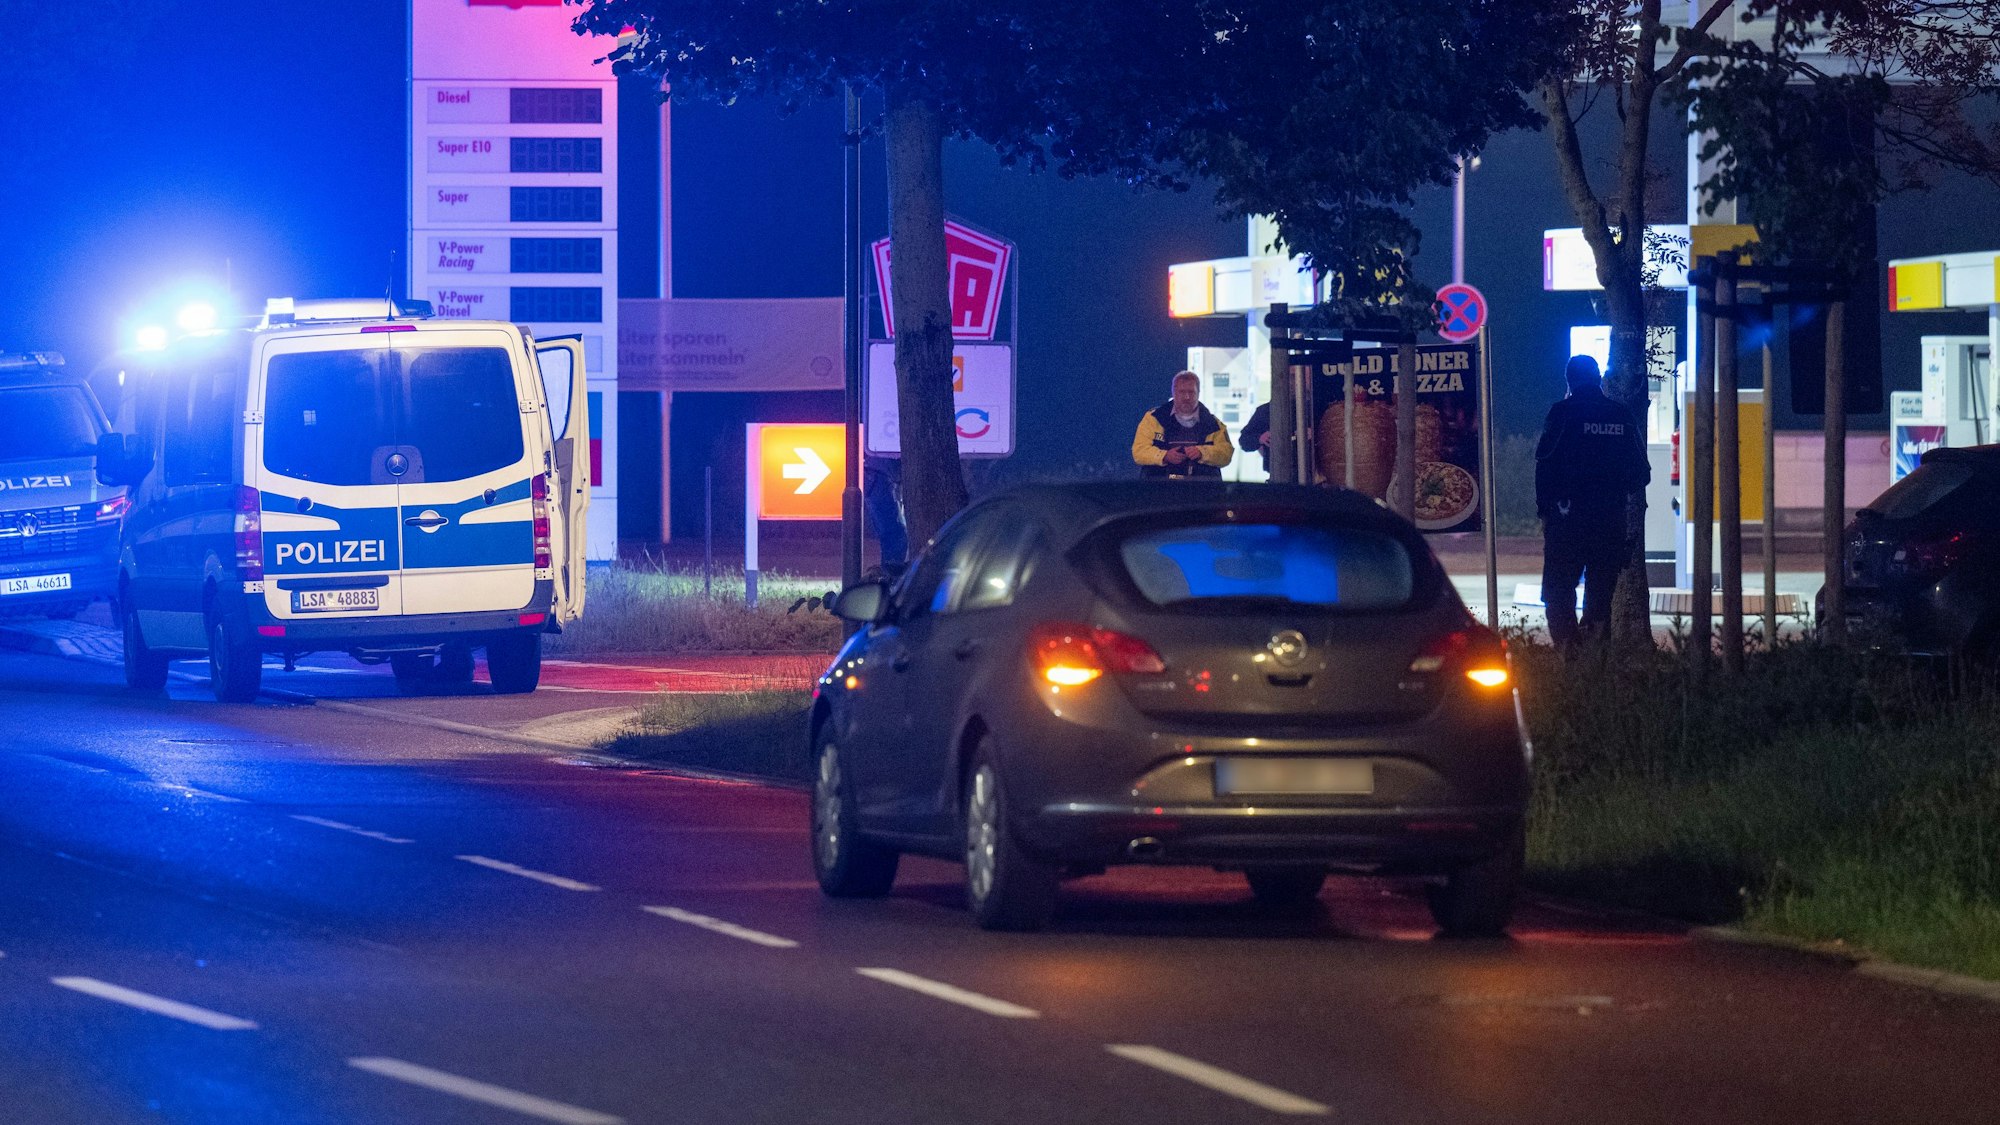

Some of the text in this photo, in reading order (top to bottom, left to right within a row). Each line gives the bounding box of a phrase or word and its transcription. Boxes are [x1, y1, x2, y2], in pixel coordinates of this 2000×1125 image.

[437, 89, 470, 103] Diesel
[437, 140, 491, 156] Super E10
[438, 189, 469, 206] Super
[438, 241, 484, 254] V-Power
[438, 255, 475, 271] Racing
[438, 291, 484, 303] V-Power
[438, 304, 471, 317] Diesel
[1368, 379, 1385, 395] &
[1583, 423, 1624, 435] POLIZEI
[276, 540, 385, 565] POLIZEI
[9, 576, 68, 592] LSA 46611
[302, 591, 376, 607] LSA 48883
